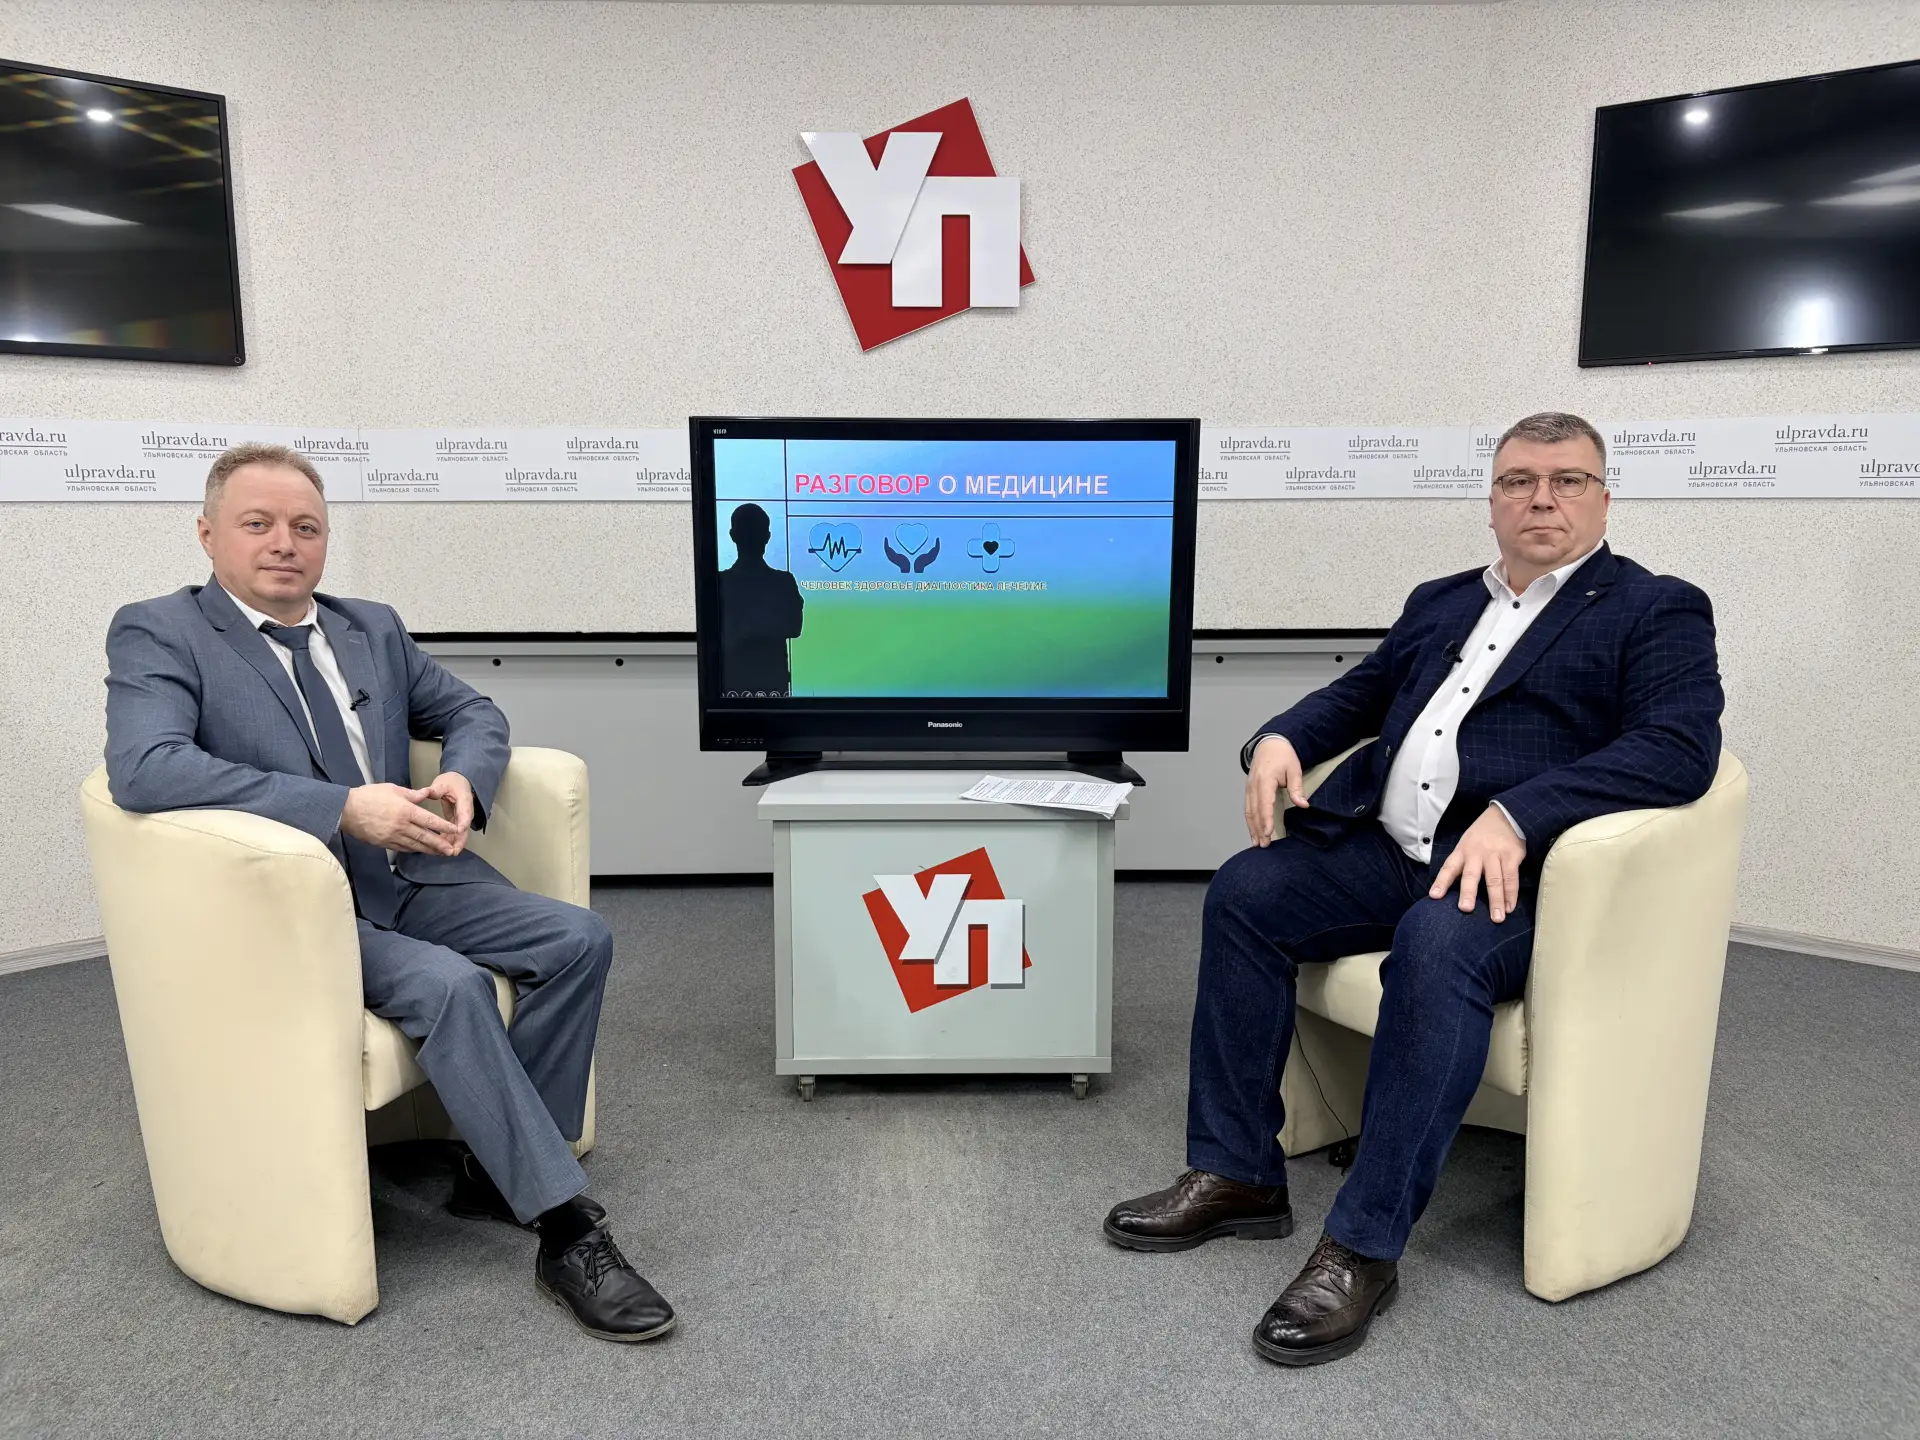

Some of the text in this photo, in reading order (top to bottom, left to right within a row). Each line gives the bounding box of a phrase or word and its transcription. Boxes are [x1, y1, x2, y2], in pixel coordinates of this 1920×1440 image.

[800, 132, 1020, 307] УП
[0, 427, 67, 443] ravda.ru
[141, 430, 228, 448] ulpravda.ru
[1613, 428, 1696, 446] ulpravda.ru
[1776, 423, 1868, 442] ulpravda.ru
[294, 435, 369, 452] ulpravda.ru
[436, 437, 508, 453] ulpravda.ru
[566, 436, 639, 452] ulpravda.ru
[1220, 436, 1291, 452] ulpravda.ru
[1348, 434, 1419, 450] ulpravda.ru
[34, 449, 68, 457] ОБЛАСТЬ
[64, 463, 156, 481] ulpravda.ru
[505, 467, 577, 483] ulpravda.ru
[636, 467, 691, 483] ulpravda
[1285, 466, 1356, 482] ulpravda.ru
[1413, 465, 1483, 480] ulpravda.ru
[1689, 460, 1777, 478] ulpravda.ru
[1860, 458, 1920, 476] ulprav
[367, 468, 439, 484] ulpravda.ru
[795, 473, 1109, 499] РАЗГОВОР О МЕДИЦИНЕ
[800, 580, 1048, 592] ЧЕЛОВЕК ЗДОРОВЬЕ ДИАГНОСТИКА ЛЕЧЕНИЕ
[872, 873, 1023, 984] УП
